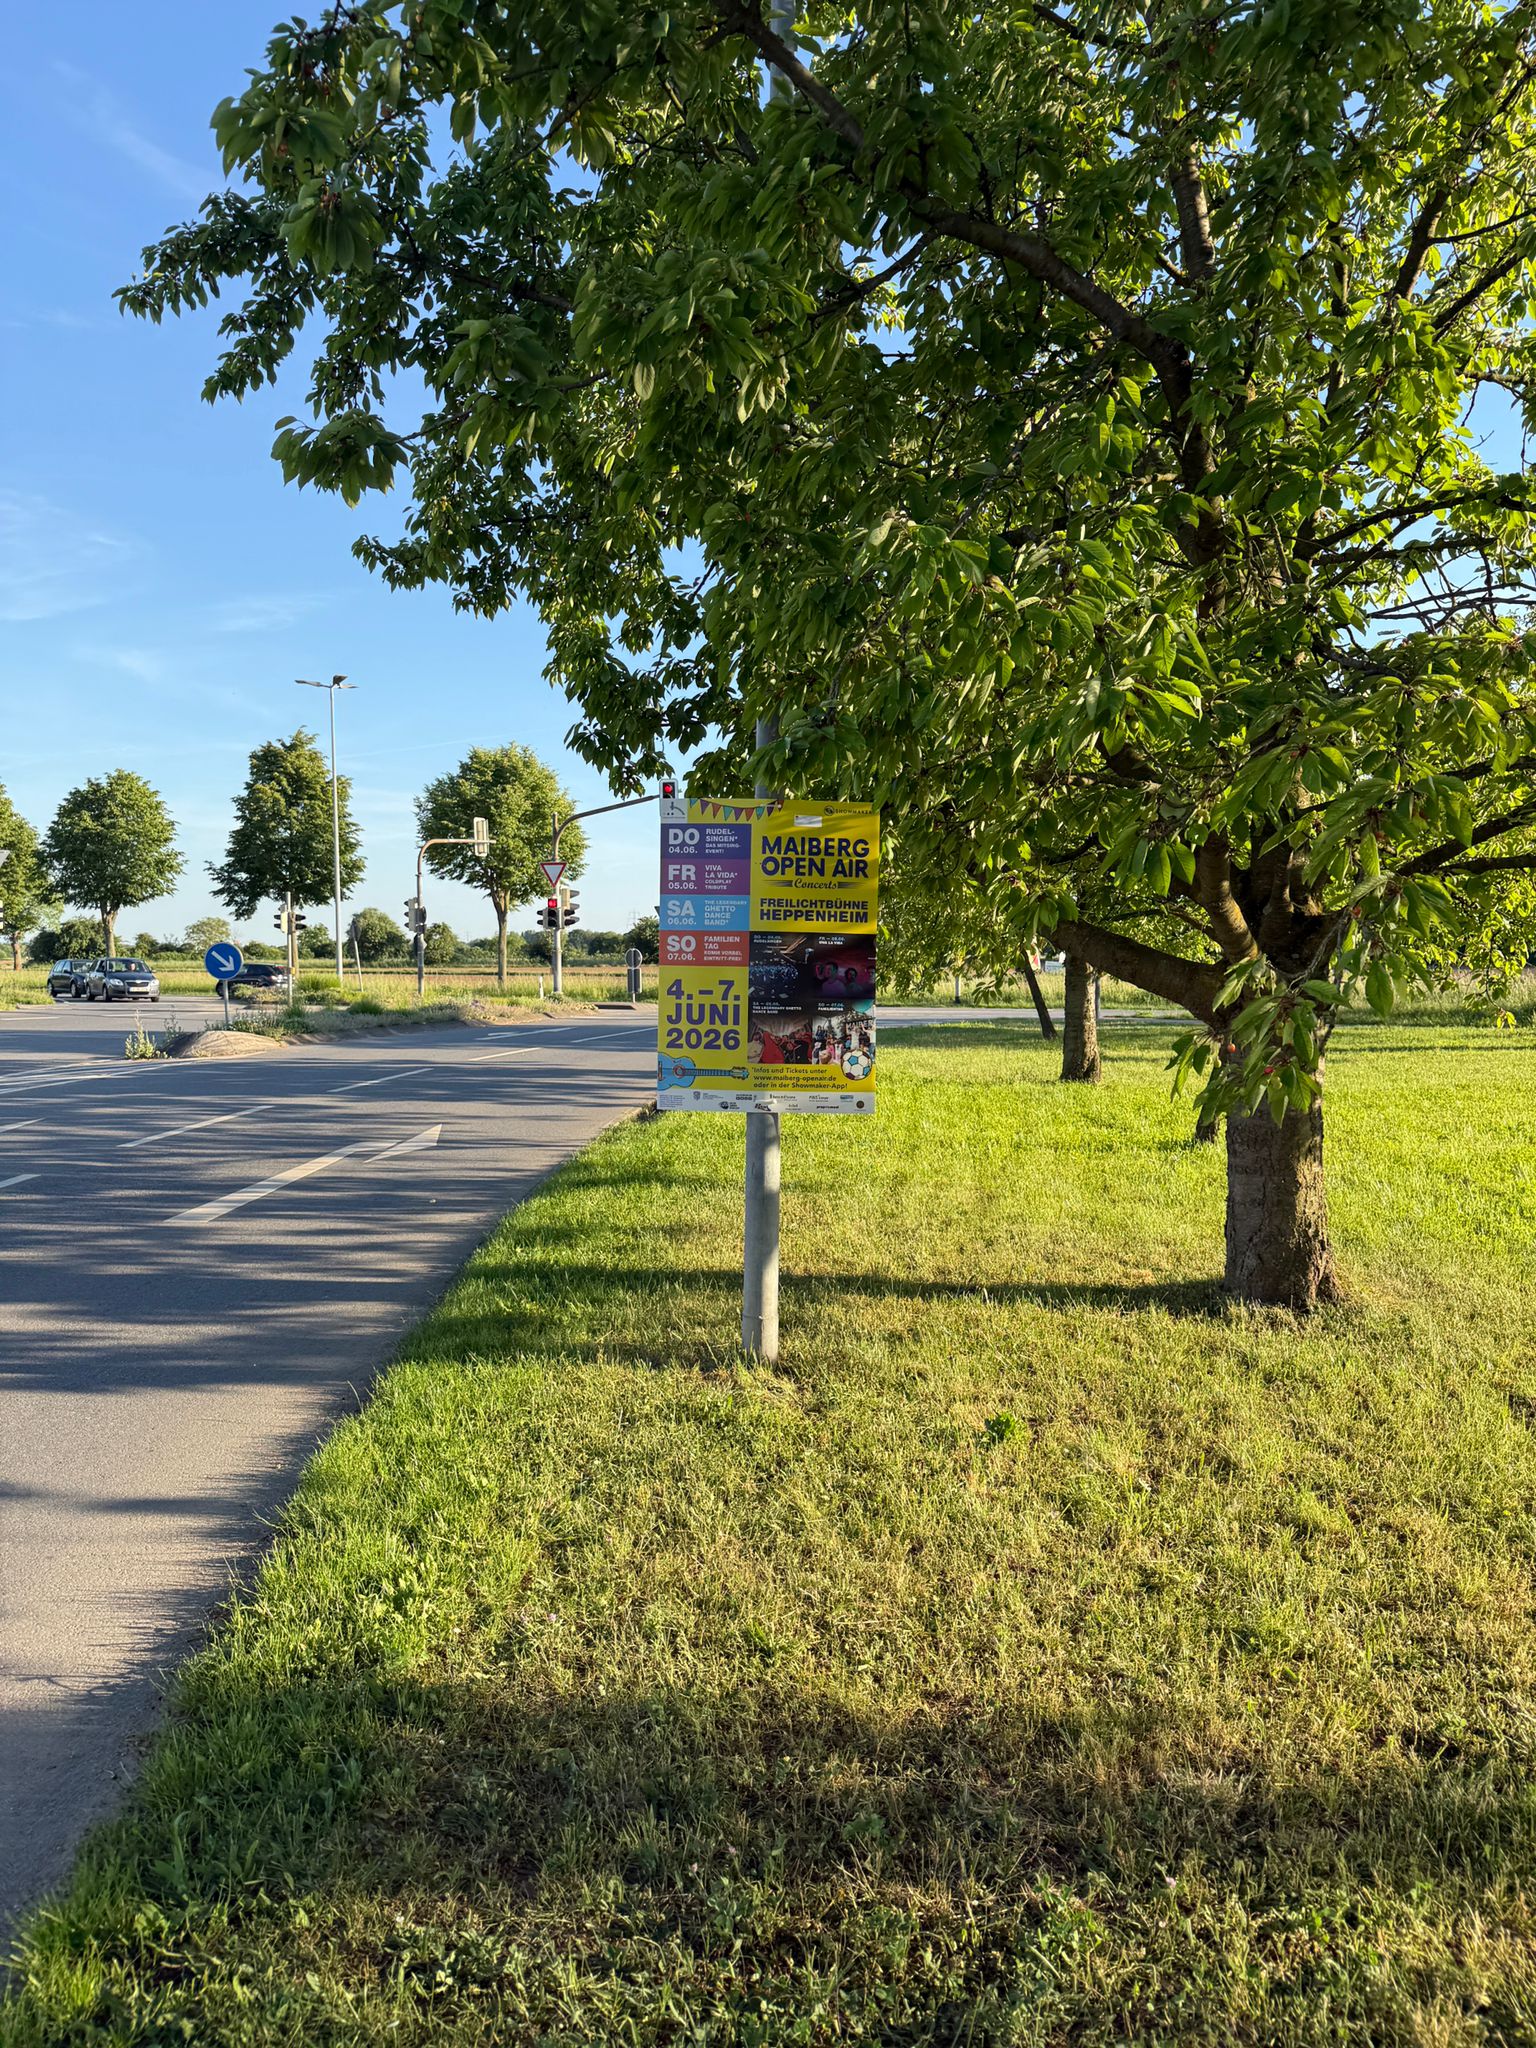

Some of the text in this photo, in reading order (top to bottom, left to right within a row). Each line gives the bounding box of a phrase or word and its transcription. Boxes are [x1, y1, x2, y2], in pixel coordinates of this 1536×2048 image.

[668, 828, 700, 845] DO
[668, 846, 698, 854] 04.06.
[761, 835, 870, 858] MAIBERG
[668, 864, 696, 880] FR
[761, 856, 869, 878] OPEN AIR
[793, 878, 838, 889] Concerts
[667, 900, 696, 916] SA
[760, 897, 869, 910] FREILICHTBÜHNE
[760, 909, 868, 923] HEPPENHEIM
[666, 935, 696, 952] SO
[666, 1003, 740, 1026] JUNI
[666, 1028, 740, 1050] 2026
